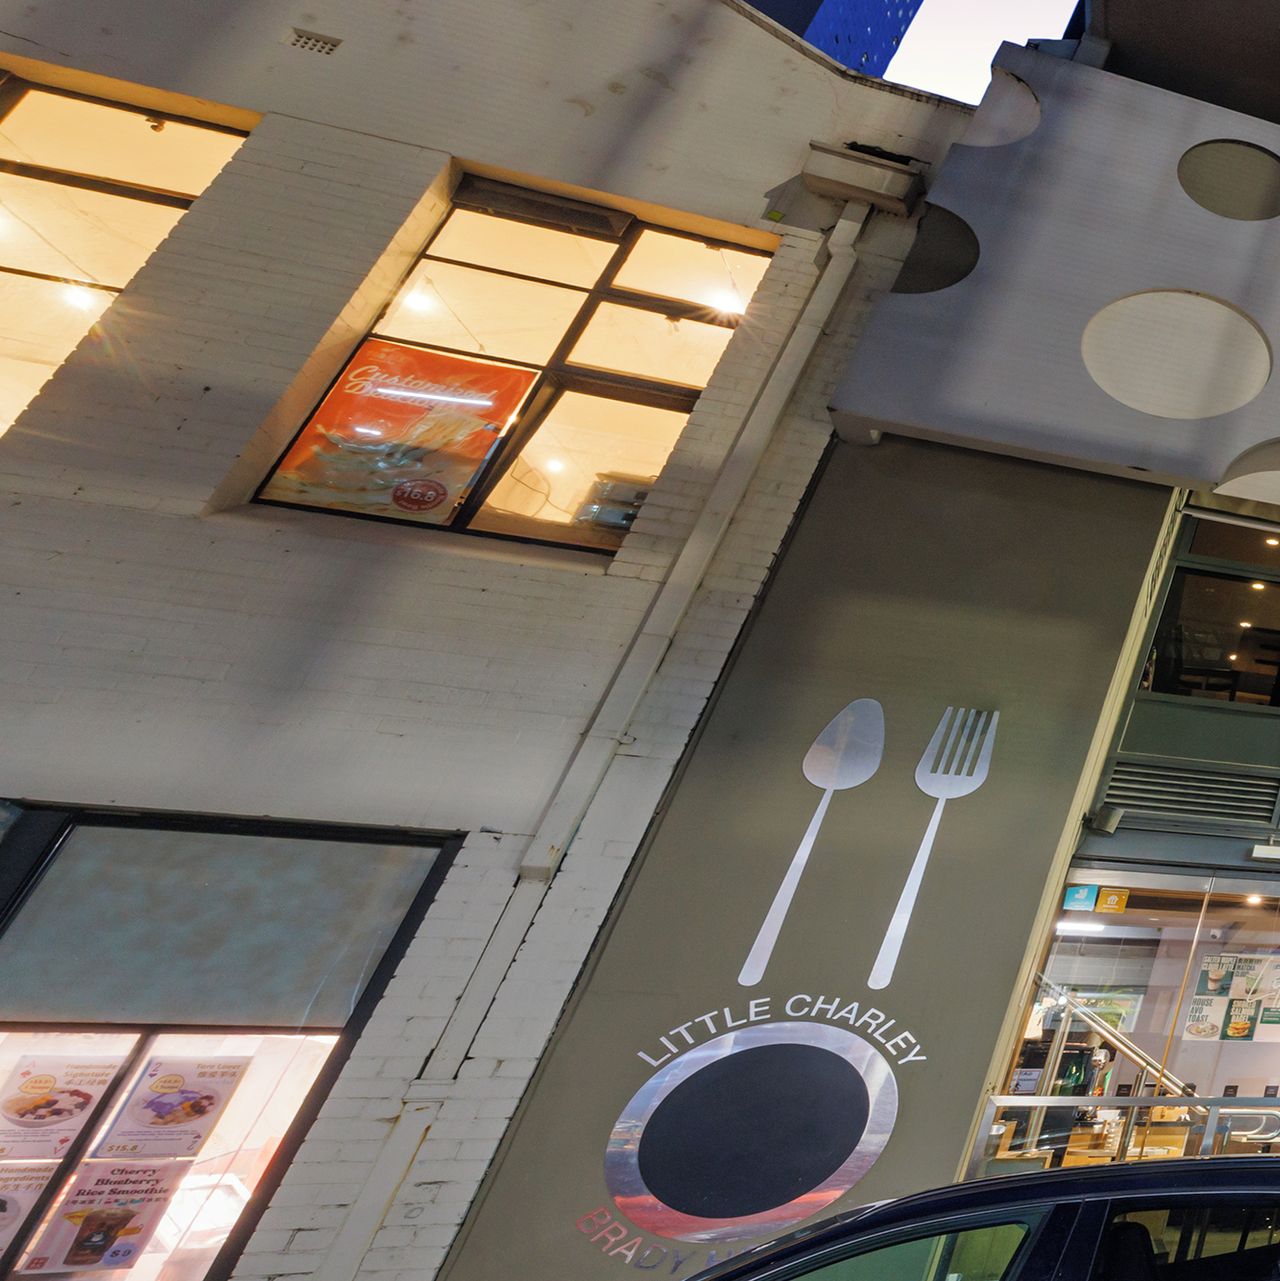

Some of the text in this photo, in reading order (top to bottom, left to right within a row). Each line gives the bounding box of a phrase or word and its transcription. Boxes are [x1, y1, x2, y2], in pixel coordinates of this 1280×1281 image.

[1191, 998, 1214, 1007] HOUSE
[636, 993, 928, 1068] LITTLE CHARLEY
[110, 1167, 161, 1177] Cherry
[94, 1178, 165, 1187] Blueberry
[75, 1187, 170, 1197] Rice Smoothie
[575, 1206, 697, 1275] BRADY
